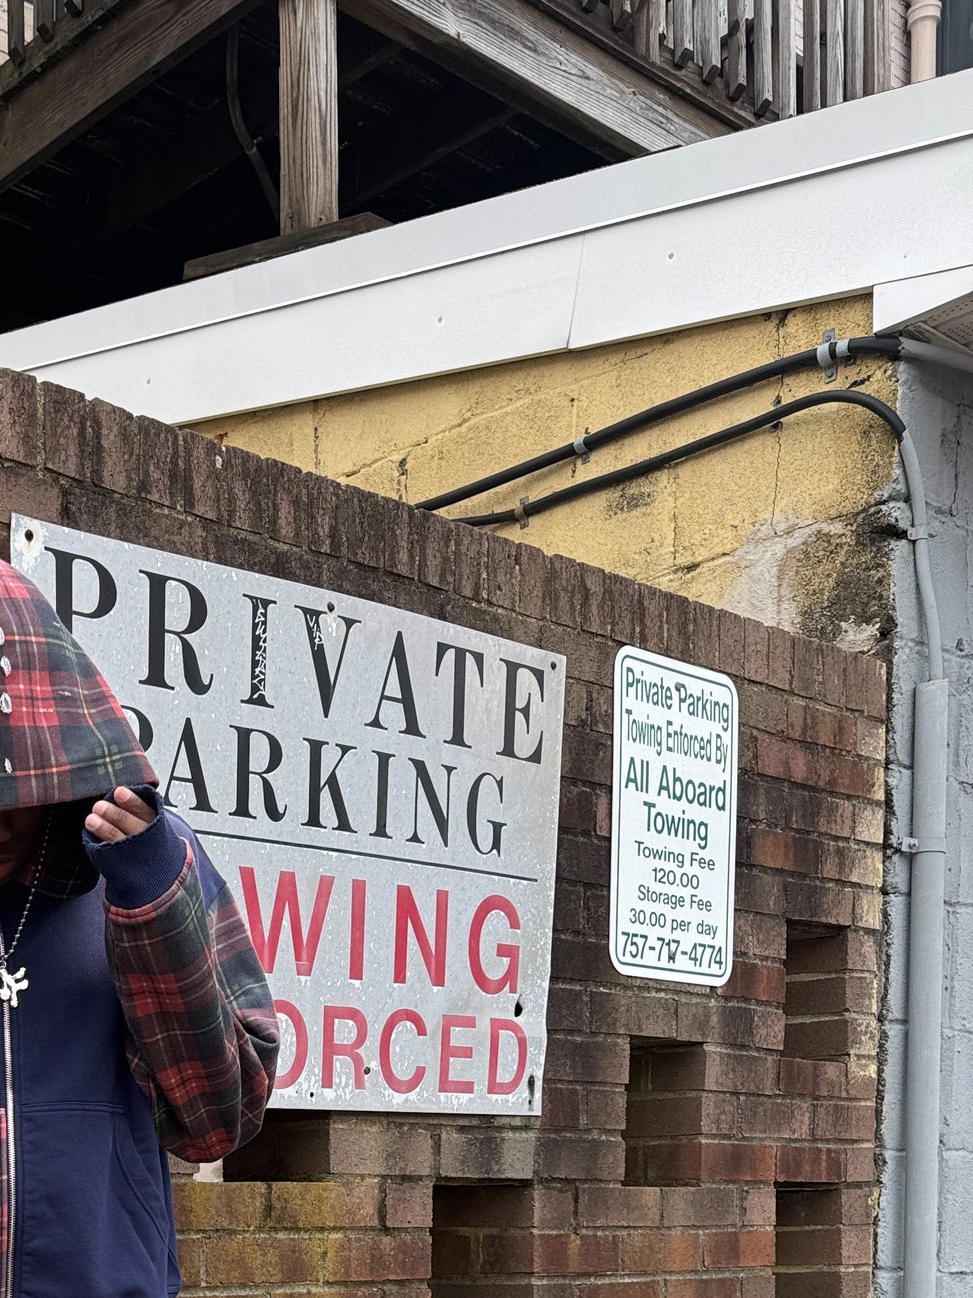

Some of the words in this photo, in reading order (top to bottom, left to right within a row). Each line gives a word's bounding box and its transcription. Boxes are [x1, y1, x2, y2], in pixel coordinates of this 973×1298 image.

[44, 546, 547, 765] PRIVATE
[626, 666, 673, 710] Private
[678, 682, 730, 732] Parking
[625, 708, 663, 757] Towing
[666, 719, 712, 763] Enforced
[715, 733, 728, 773] By
[121, 704, 507, 857] ARKING
[624, 756, 650, 794] All
[657, 764, 727, 812] Aboard
[642, 800, 709, 850] Towing
[634, 840, 685, 868] Towing
[690, 852, 716, 871] Fee
[652, 867, 700, 890] 120.00
[629, 908, 667, 928] 30.00
[670, 918, 692, 934] per
[696, 920, 718, 940] day
[637, 884, 685, 910] Storage
[690, 894, 713, 912] Fee
[239, 865, 521, 996] WING
[621, 931, 724, 970] 757-717-4774
[274, 999, 528, 1097] ORCED
